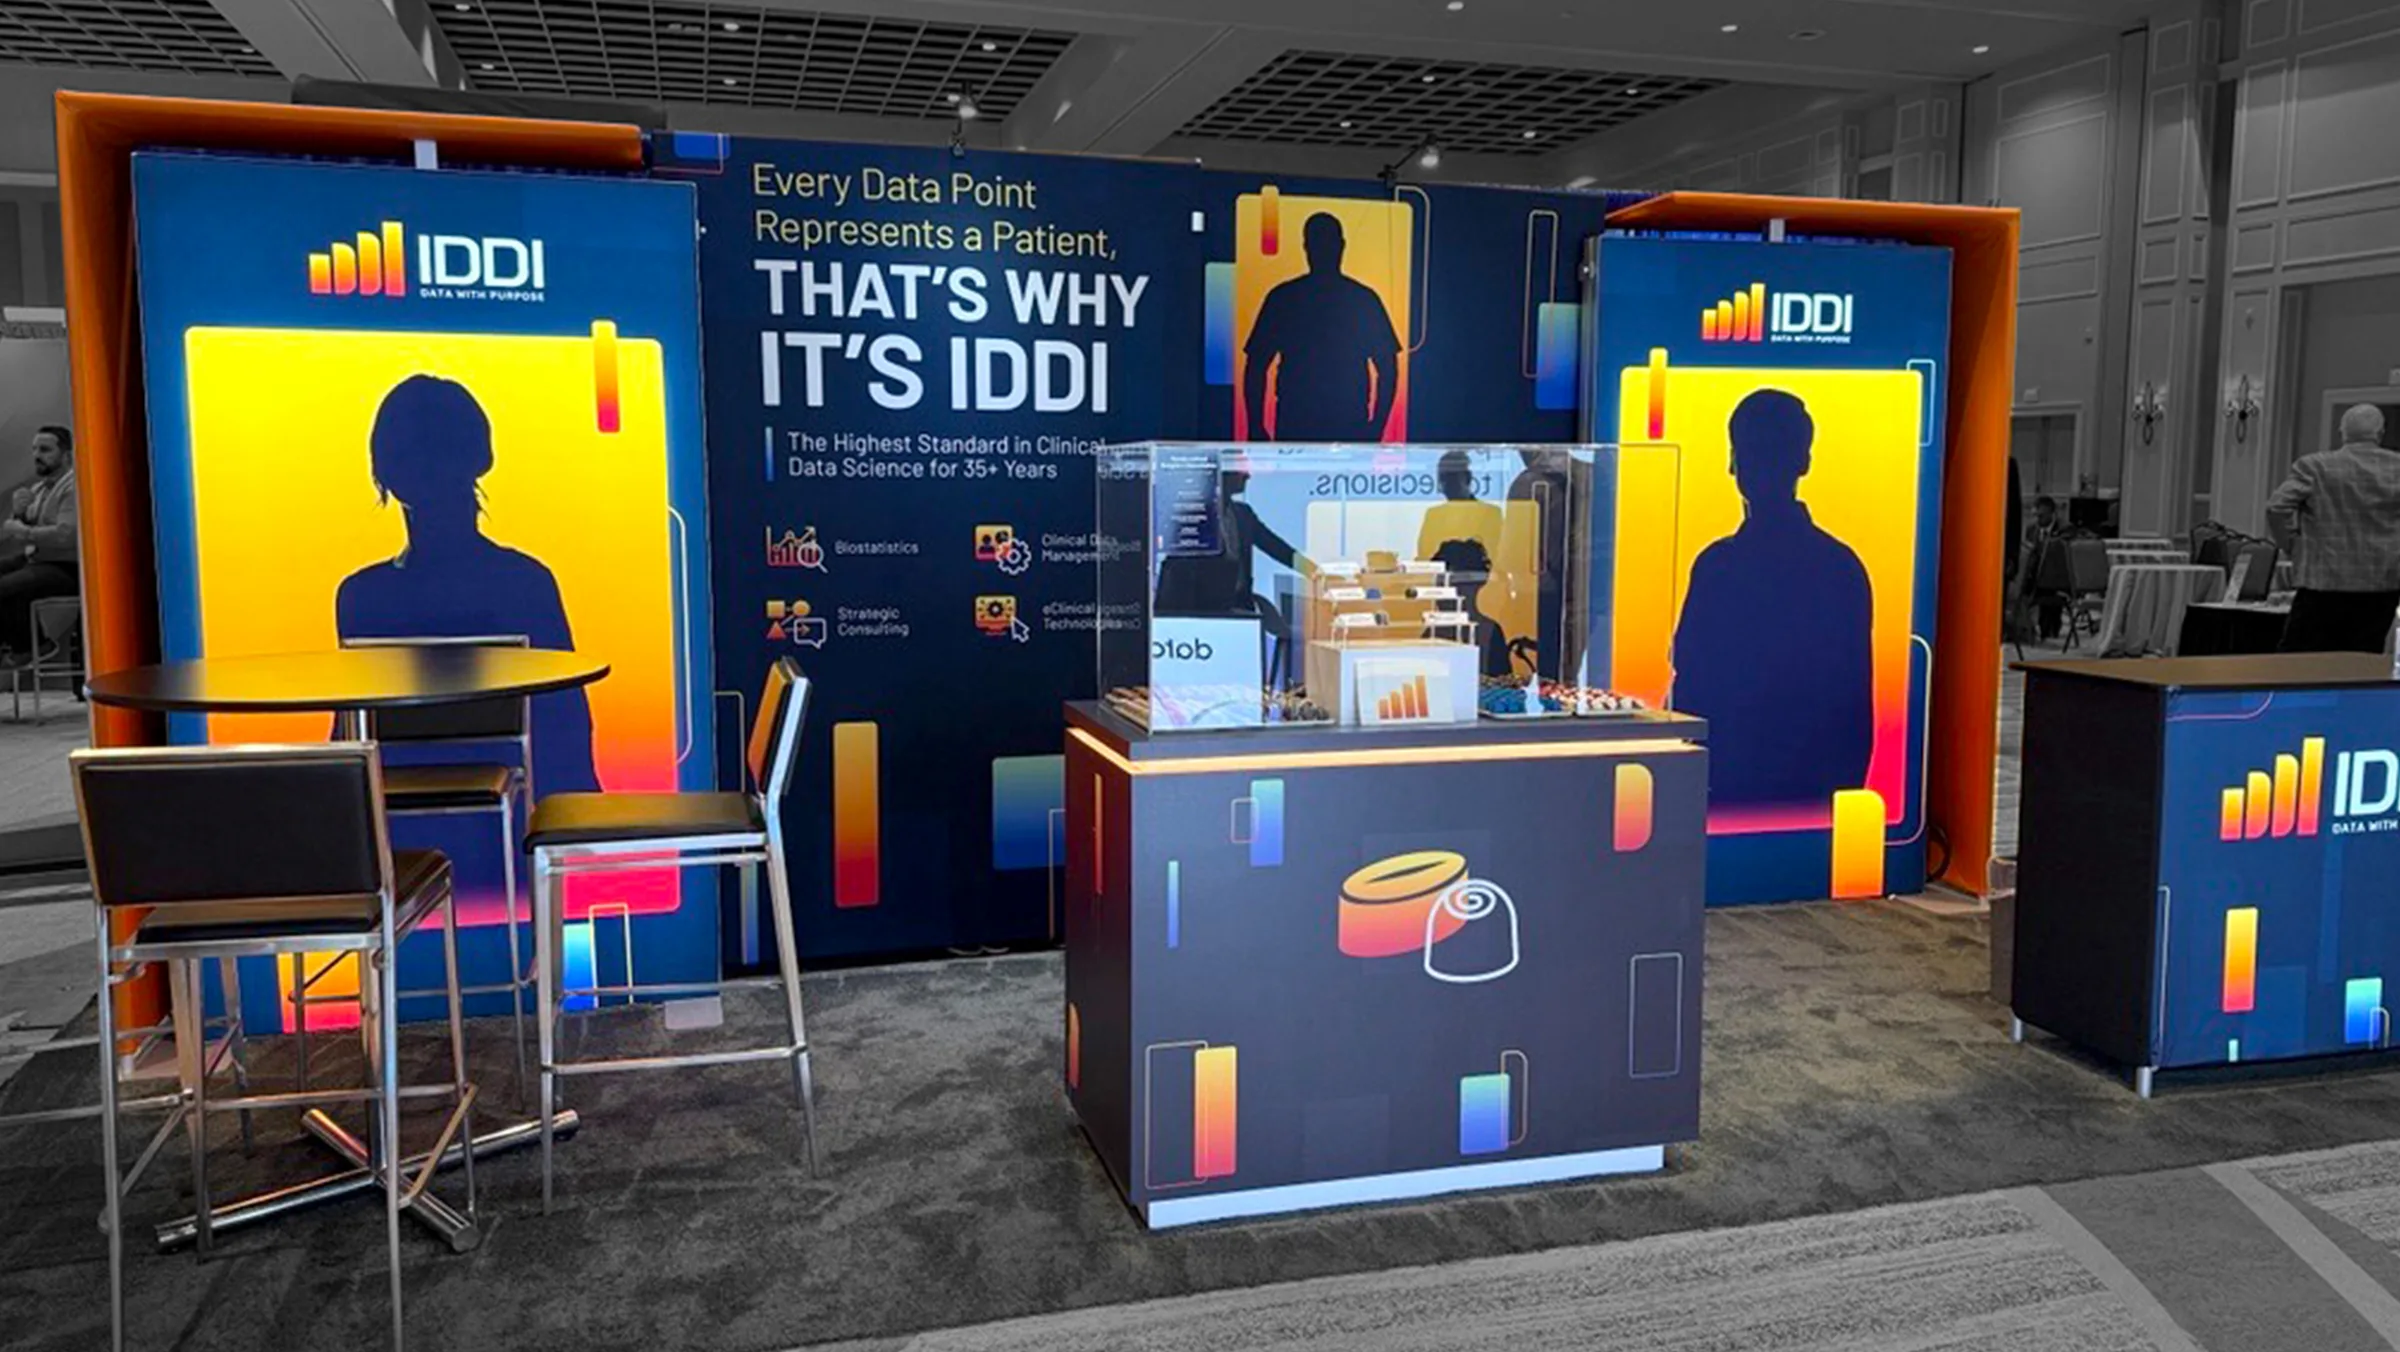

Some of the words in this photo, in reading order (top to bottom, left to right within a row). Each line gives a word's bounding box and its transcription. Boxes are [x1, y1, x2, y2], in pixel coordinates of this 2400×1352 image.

[753, 163, 851, 206] Every
[862, 167, 940, 204] Data
[952, 173, 1036, 210] Point
[756, 210, 953, 251] Represents
[964, 227, 982, 252] a
[993, 221, 1117, 260] Patient,
[418, 233, 544, 289] IDDI
[420, 288, 452, 298] DATA
[455, 289, 486, 299] WITH
[490, 290, 544, 302] PURPOSE
[754, 259, 988, 323] THAT’S
[1004, 269, 1150, 328] WHY
[1771, 292, 1853, 333] IDDI
[760, 331, 924, 410] IT’S
[950, 336, 1108, 413] IDDI
[788, 431, 827, 452] The
[834, 433, 912, 457] Highest
[917, 434, 1008, 455] Standard
[1014, 435, 1031, 455] in
[1037, 435, 1105, 456] Clinical
[789, 457, 838, 478] Data
[843, 458, 924, 479] Science
[929, 458, 958, 479] for
[963, 460, 998, 479] 35+
[1005, 460, 1058, 479] Years
[835, 539, 919, 556] Biostatistics
[1042, 532, 1087, 548] Clinical
[837, 606, 900, 624] Strategic
[1042, 602, 1096, 616] eClinical
[838, 620, 909, 638] Consulting
[2332, 821, 2366, 835] DATA
[2369, 819, 2399, 833] WITH
